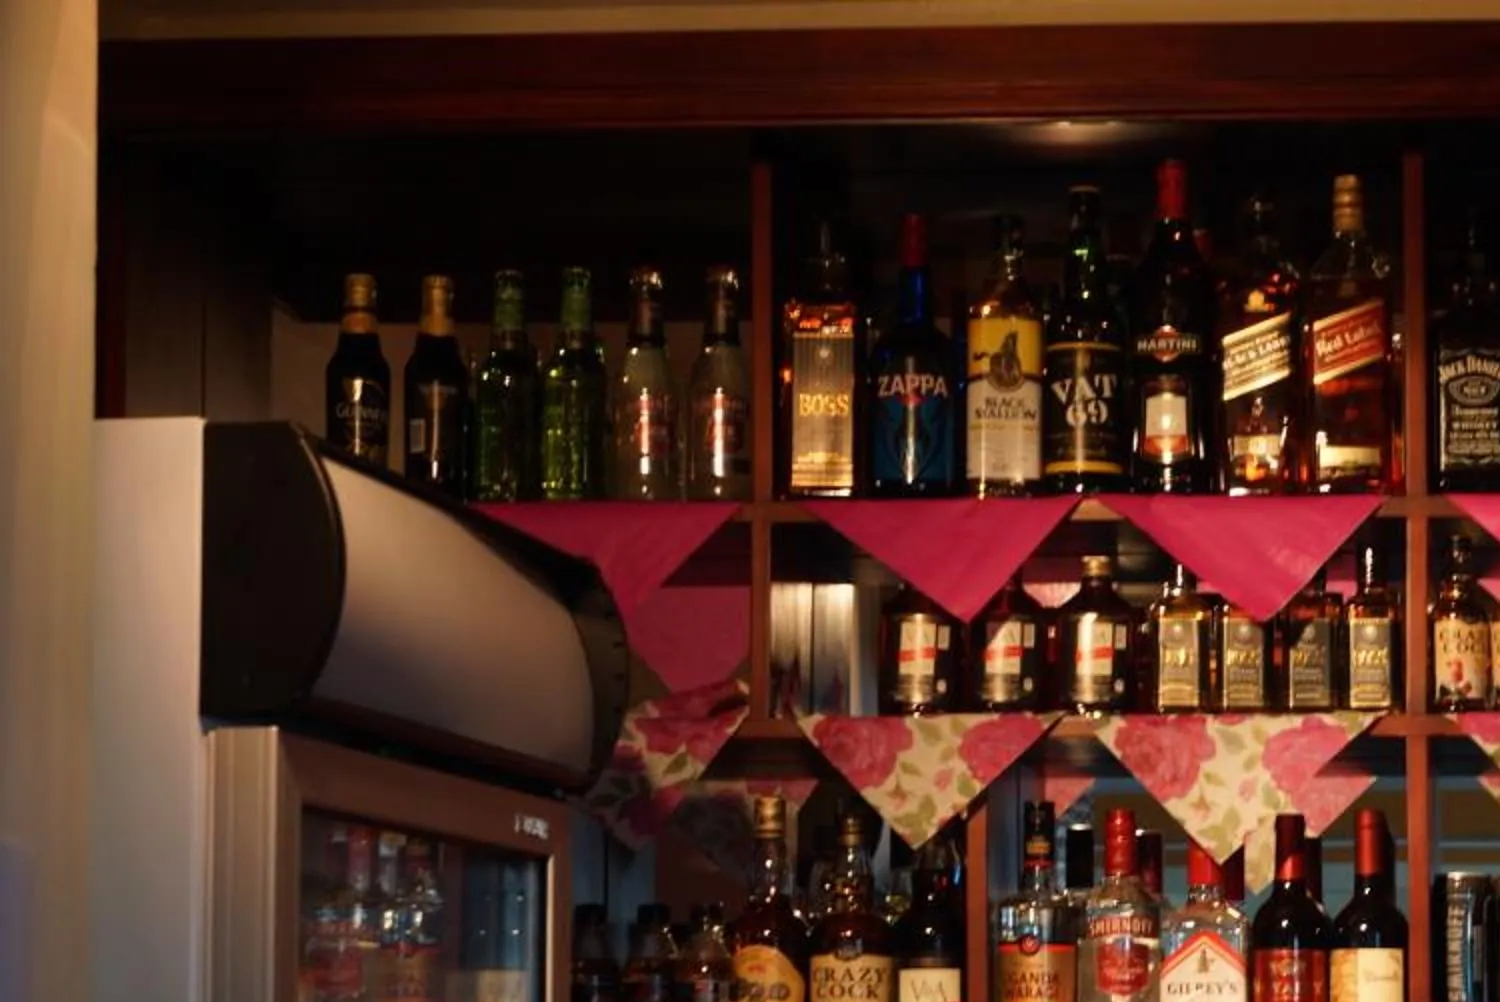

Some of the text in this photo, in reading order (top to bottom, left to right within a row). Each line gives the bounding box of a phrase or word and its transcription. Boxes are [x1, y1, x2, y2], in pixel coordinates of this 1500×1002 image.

[1136, 336, 1197, 353] MARTINI
[877, 373, 949, 399] ZAPPA
[1050, 373, 1118, 406] VAT
[799, 393, 849, 418] BOSS
[1065, 399, 1108, 428] 69
[1088, 915, 1153, 939] SMIRNOFF
[812, 966, 886, 985] CRAZY
[815, 984, 880, 1000] COCK
